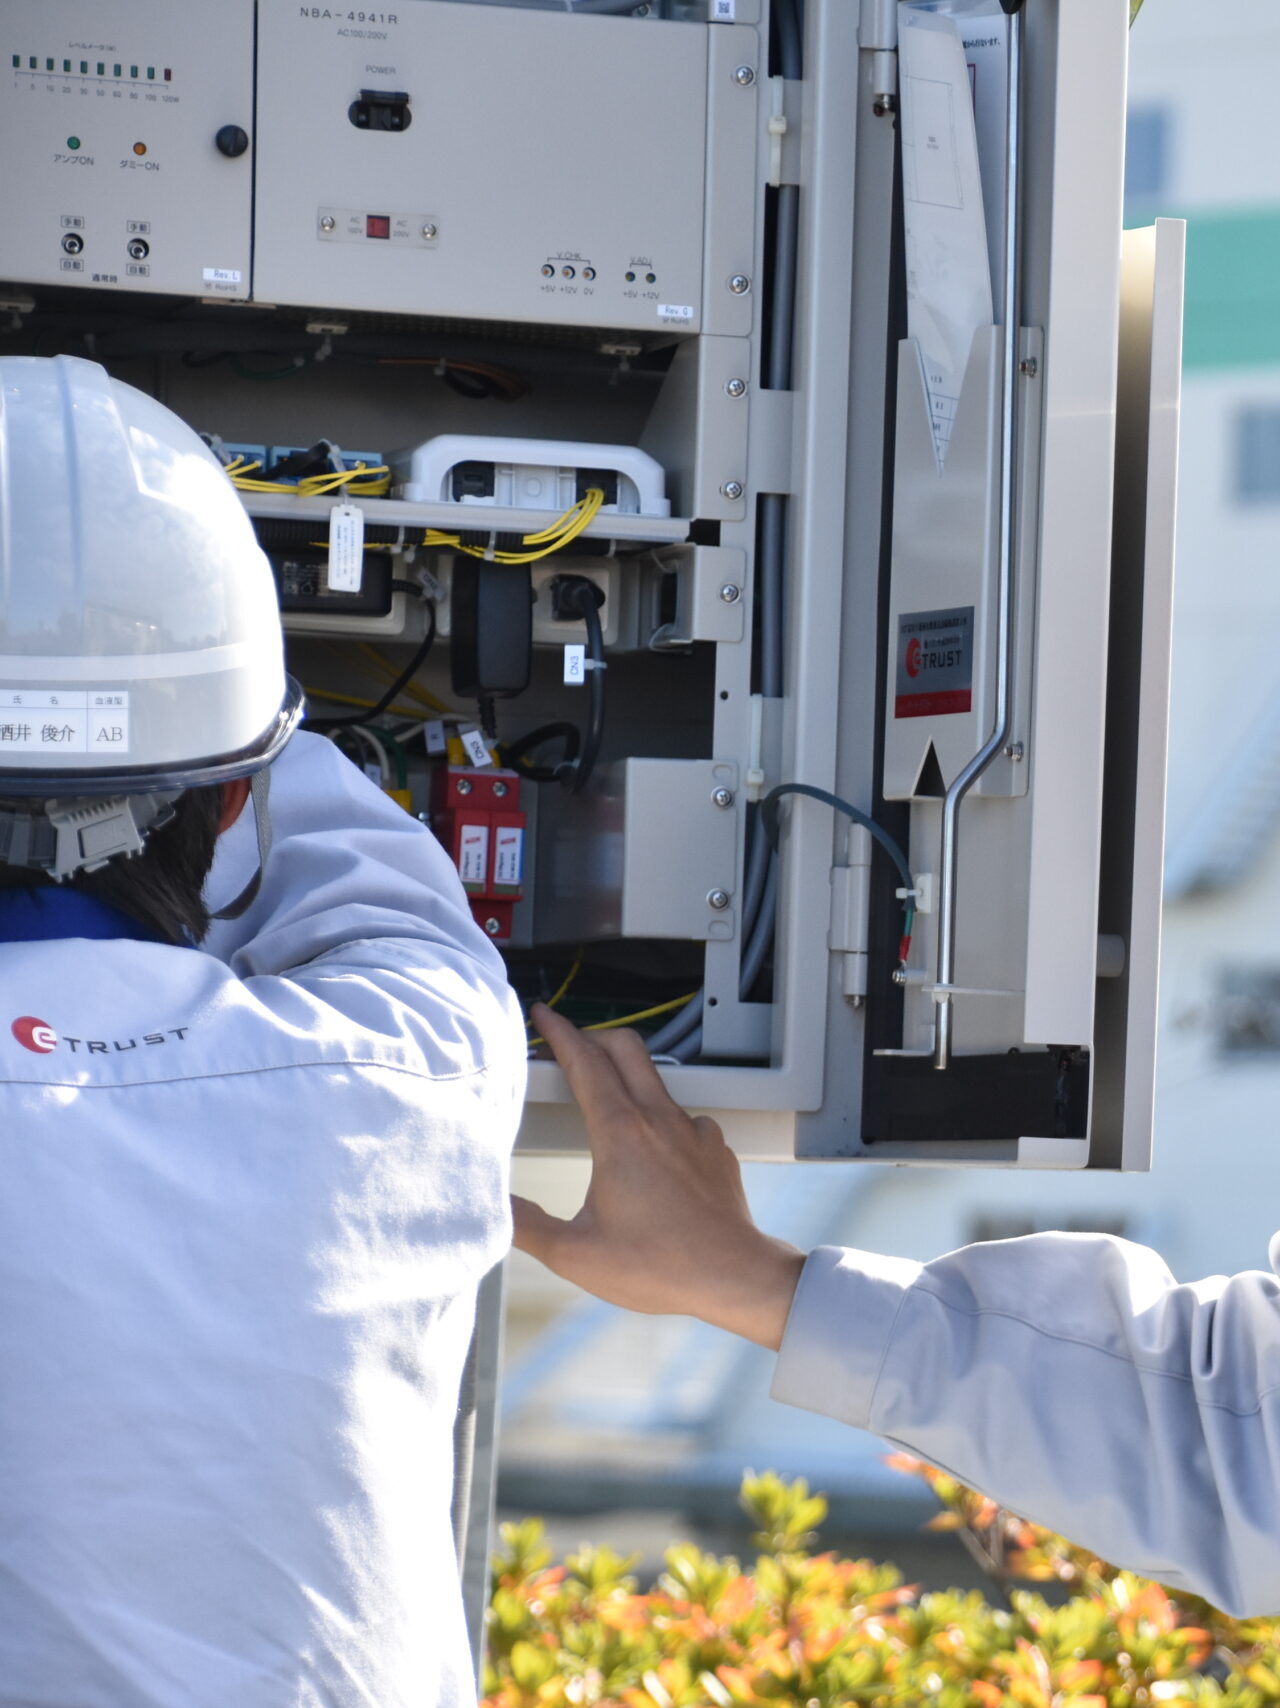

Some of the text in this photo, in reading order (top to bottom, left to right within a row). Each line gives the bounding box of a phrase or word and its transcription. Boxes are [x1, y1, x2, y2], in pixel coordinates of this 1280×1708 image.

[365, 64, 396, 75] POWER
[53, 153, 95, 166] アンプON
[119, 160, 160, 171] ダミーON
[96, 726, 123, 742] AB
[63, 1027, 189, 1054] TRUST
